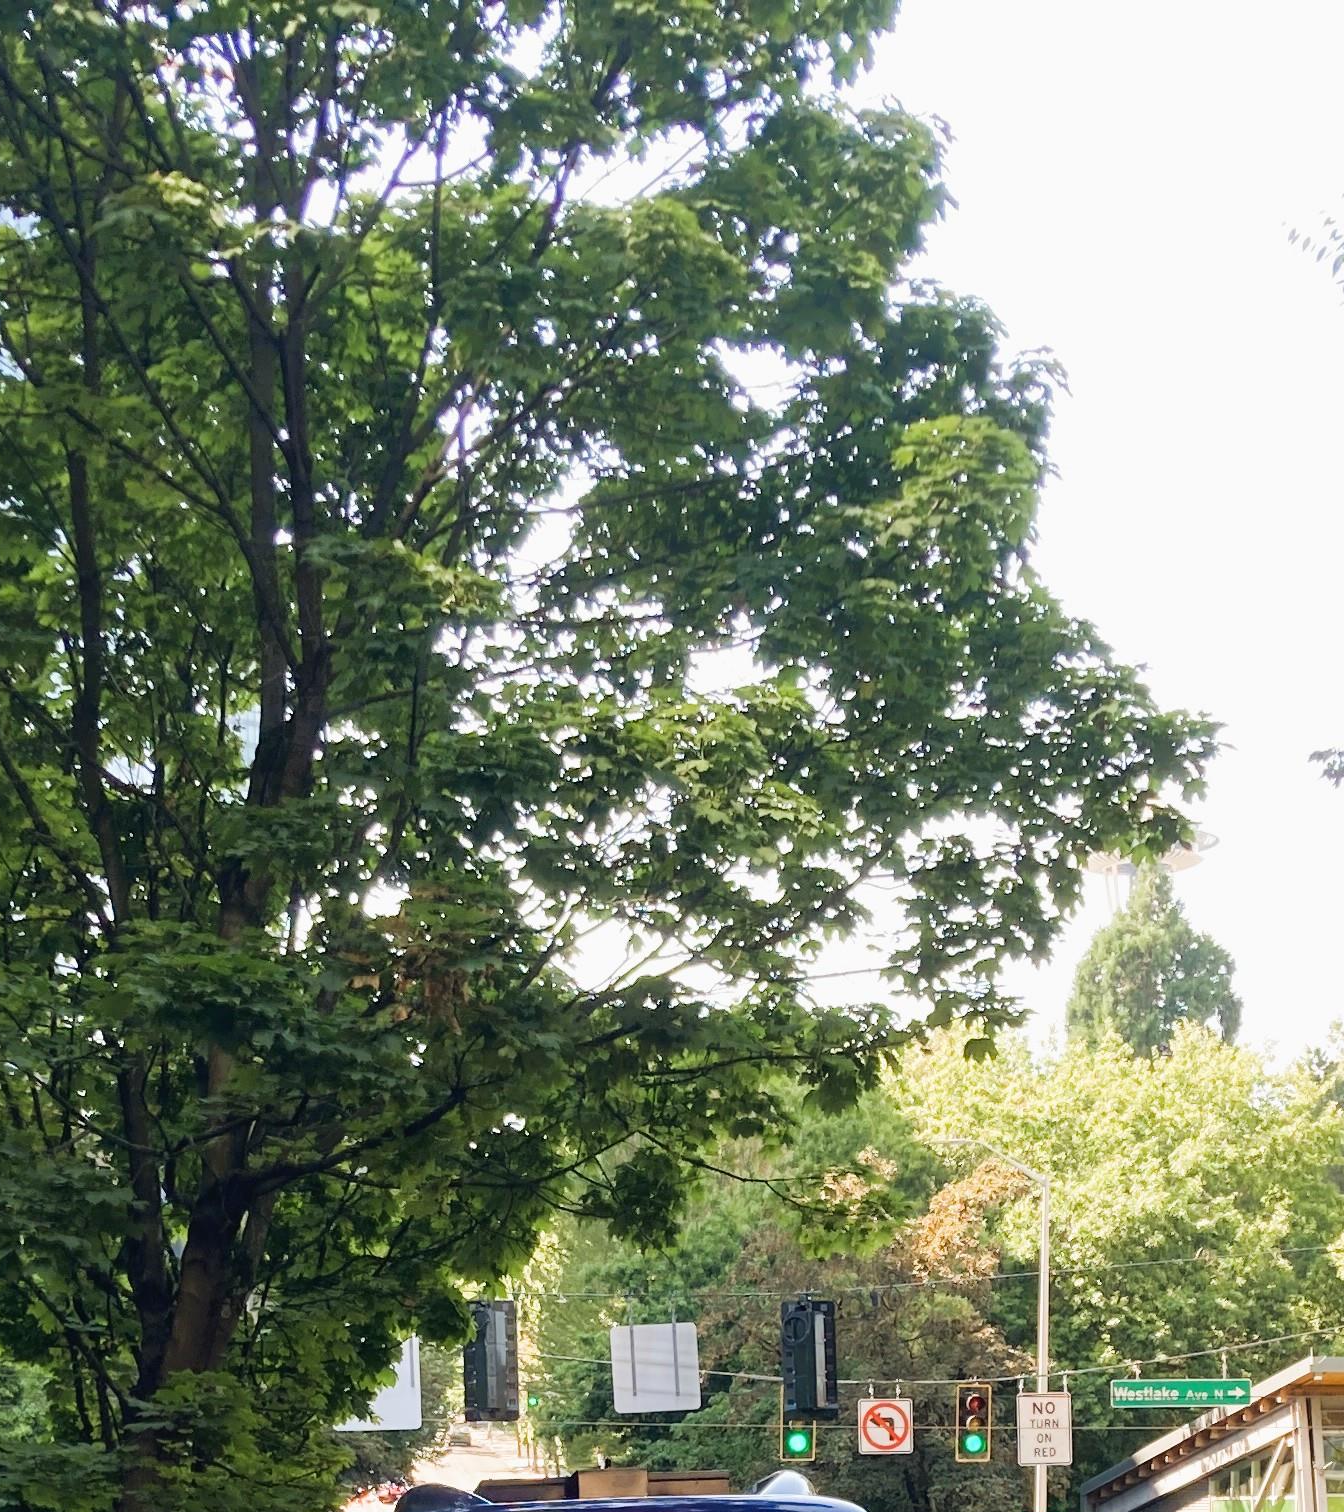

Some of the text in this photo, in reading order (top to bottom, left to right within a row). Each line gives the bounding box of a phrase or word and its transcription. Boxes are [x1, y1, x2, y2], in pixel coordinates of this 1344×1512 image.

[1114, 1386, 1224, 1401] Westlake Ave N
[1032, 1401, 1056, 1415] NO
[1030, 1418, 1059, 1429] TURN
[1036, 1432, 1052, 1444] ON
[1034, 1447, 1056, 1457] RED
